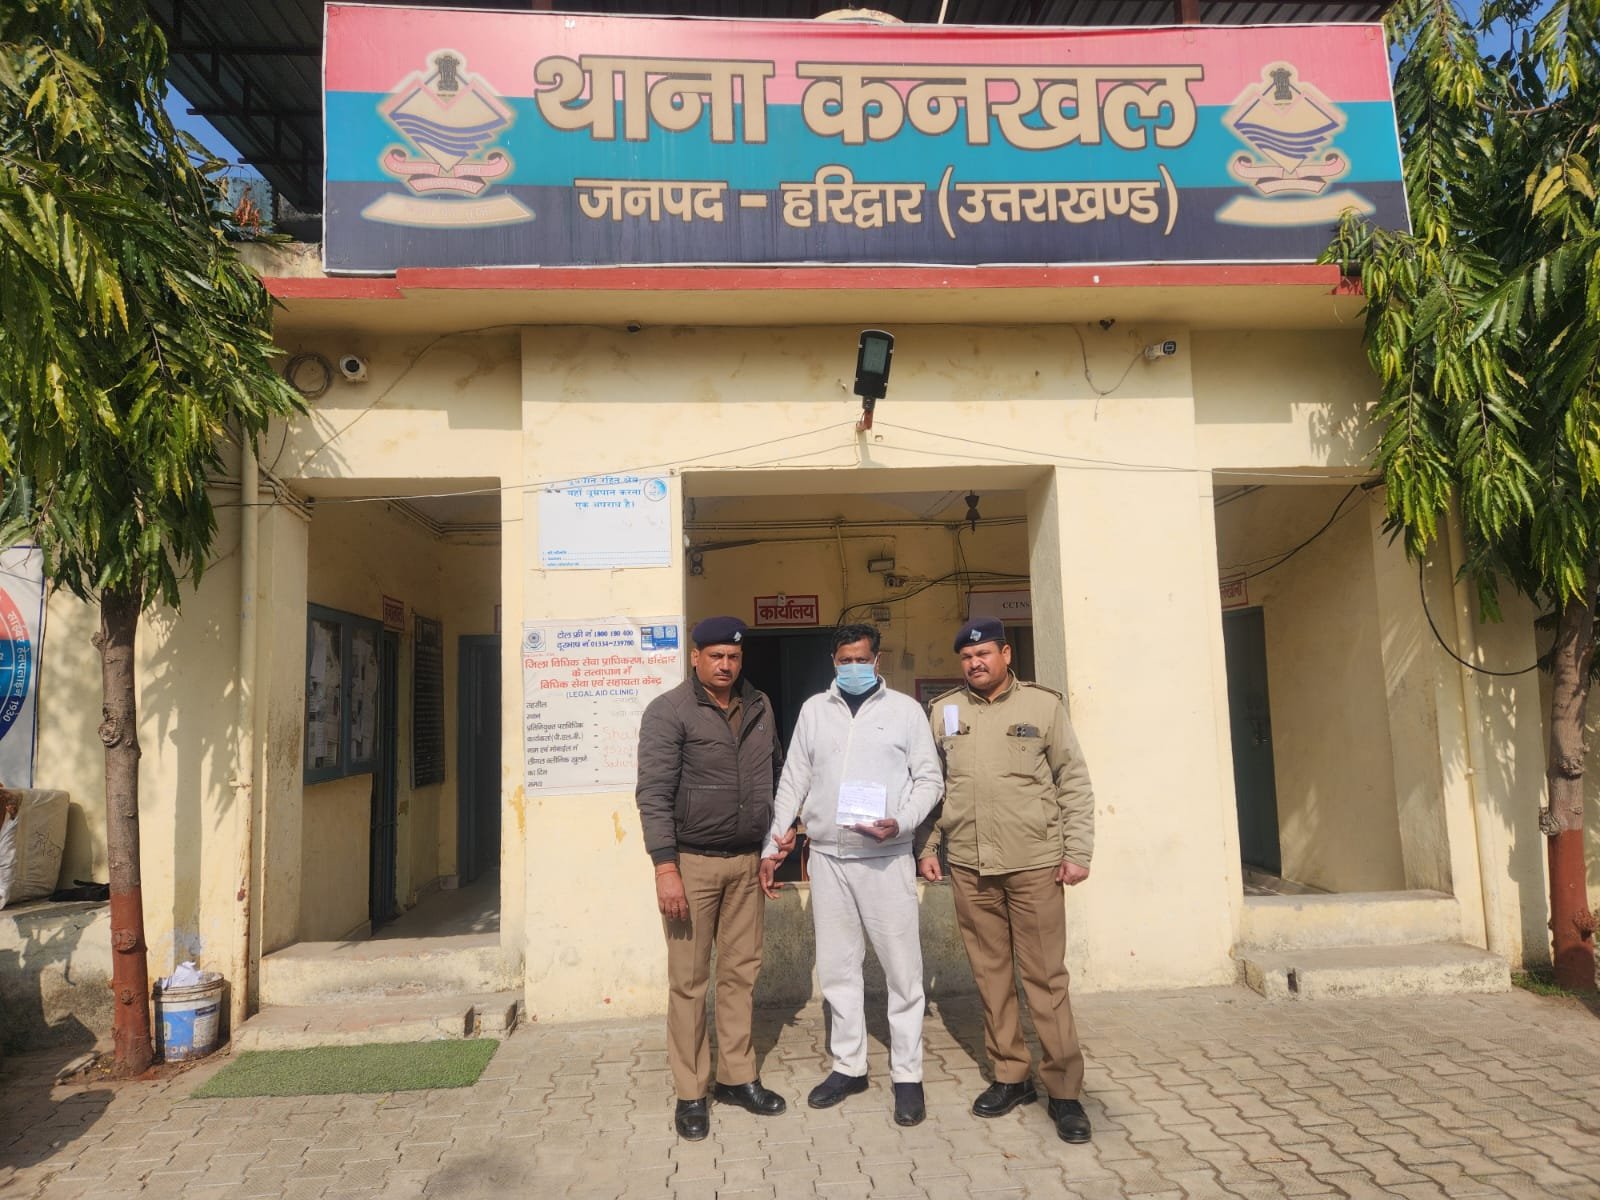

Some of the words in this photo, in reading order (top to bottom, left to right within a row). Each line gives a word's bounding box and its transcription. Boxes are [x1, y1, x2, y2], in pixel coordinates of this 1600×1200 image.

[533, 54, 776, 144] थाना
[795, 61, 1205, 151] कनखल
[573, 178, 728, 223] जनपद
[778, 164, 927, 231] हरिद्वार
[936, 163, 1180, 240] (उत्तराखण्ड)
[758, 600, 815, 620] कार्यालय
[557, 630, 571, 640] टोल
[525, 657, 549, 669] जिला
[552, 656, 580, 668] विधिक
[582, 656, 599, 666] सेवा
[572, 667, 581, 677] के
[623, 665, 633, 675] में
[540, 678, 568, 690] विधिक
[572, 678, 589, 688] सेवा
[591, 677, 605, 688] एवं
[566, 689, 593, 699] (LEGAL
[3, 701, 20, 723] 1930
